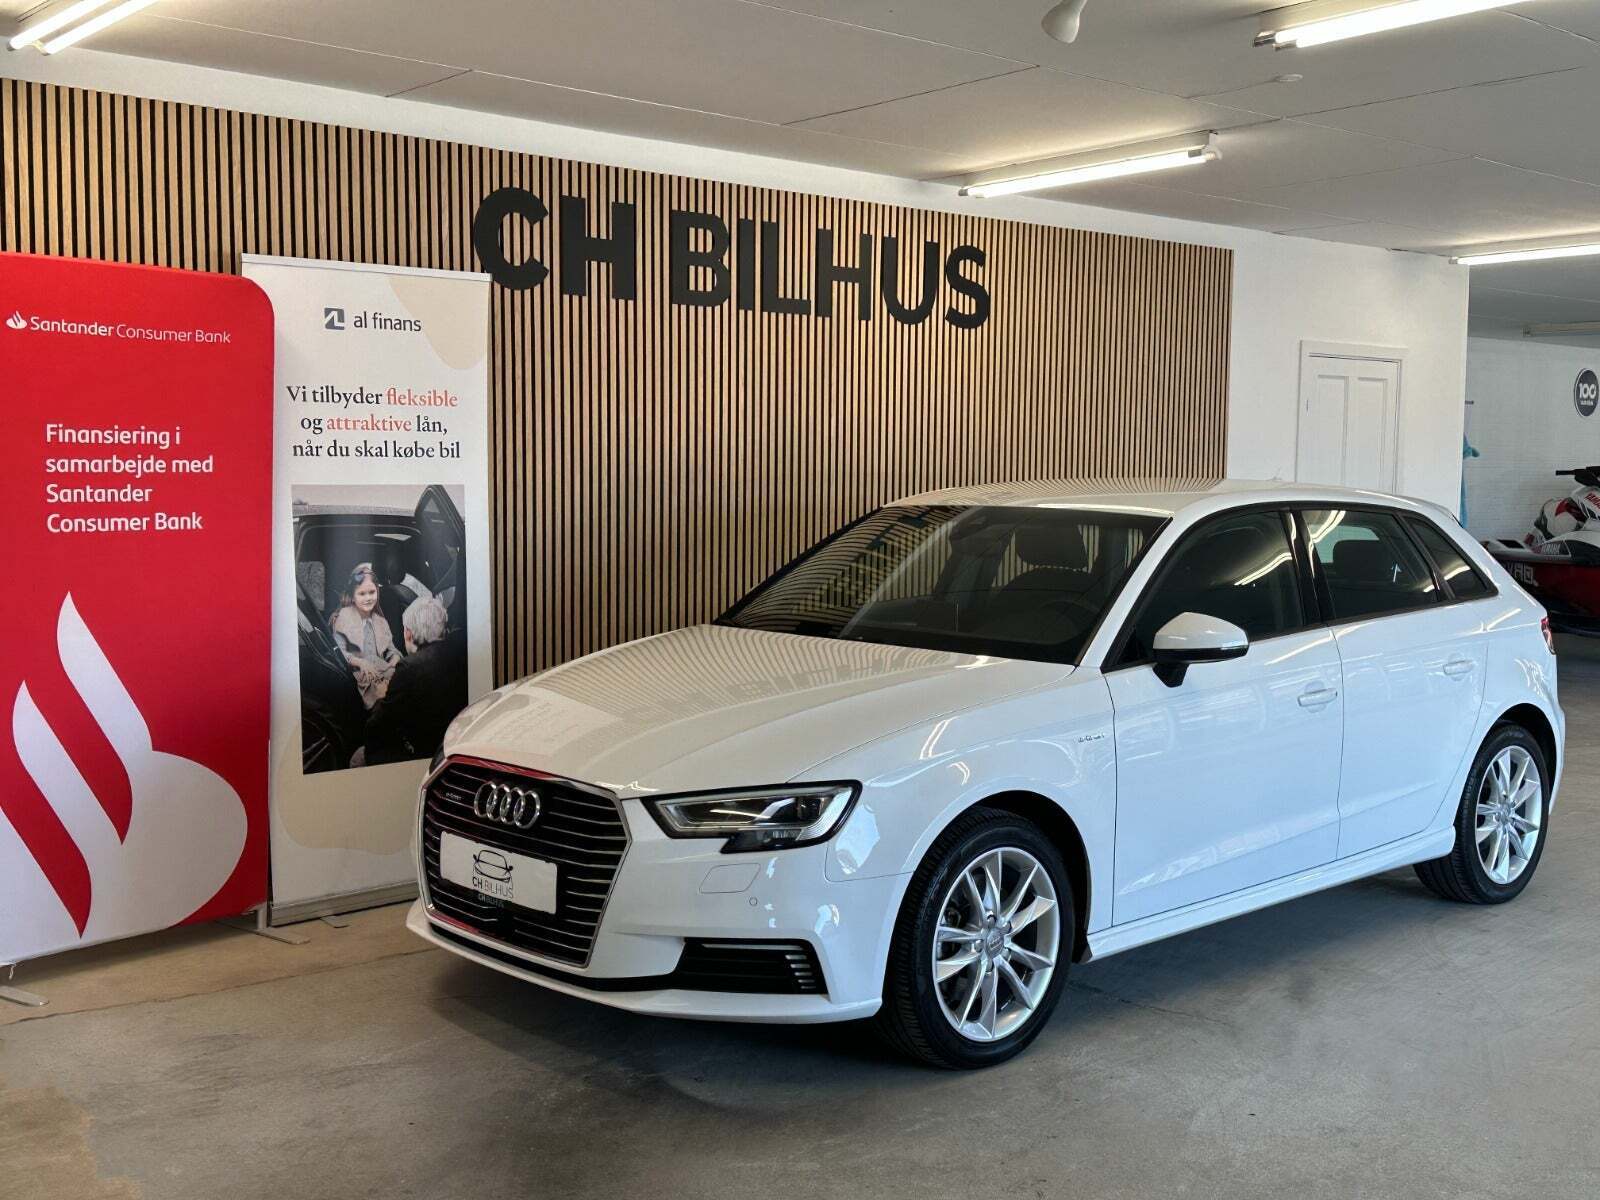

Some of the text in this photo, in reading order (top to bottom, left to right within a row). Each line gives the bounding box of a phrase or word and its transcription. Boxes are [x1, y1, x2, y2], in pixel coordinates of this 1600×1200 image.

[473, 186, 991, 330] CH BILHUS
[30, 315, 231, 344] Santander Consumer Bank
[353, 311, 422, 332] al finans
[286, 385, 458, 408] Vi tilbyder fleksible
[300, 414, 448, 436] og attraktive lån,
[46, 423, 181, 450] Finansiering i
[292, 439, 461, 459] når du skal købe bil
[45, 454, 213, 478] samarbejde med
[46, 483, 153, 503] Santander
[47, 512, 203, 533] Consumer Bank
[472, 876, 483, 889] CH
